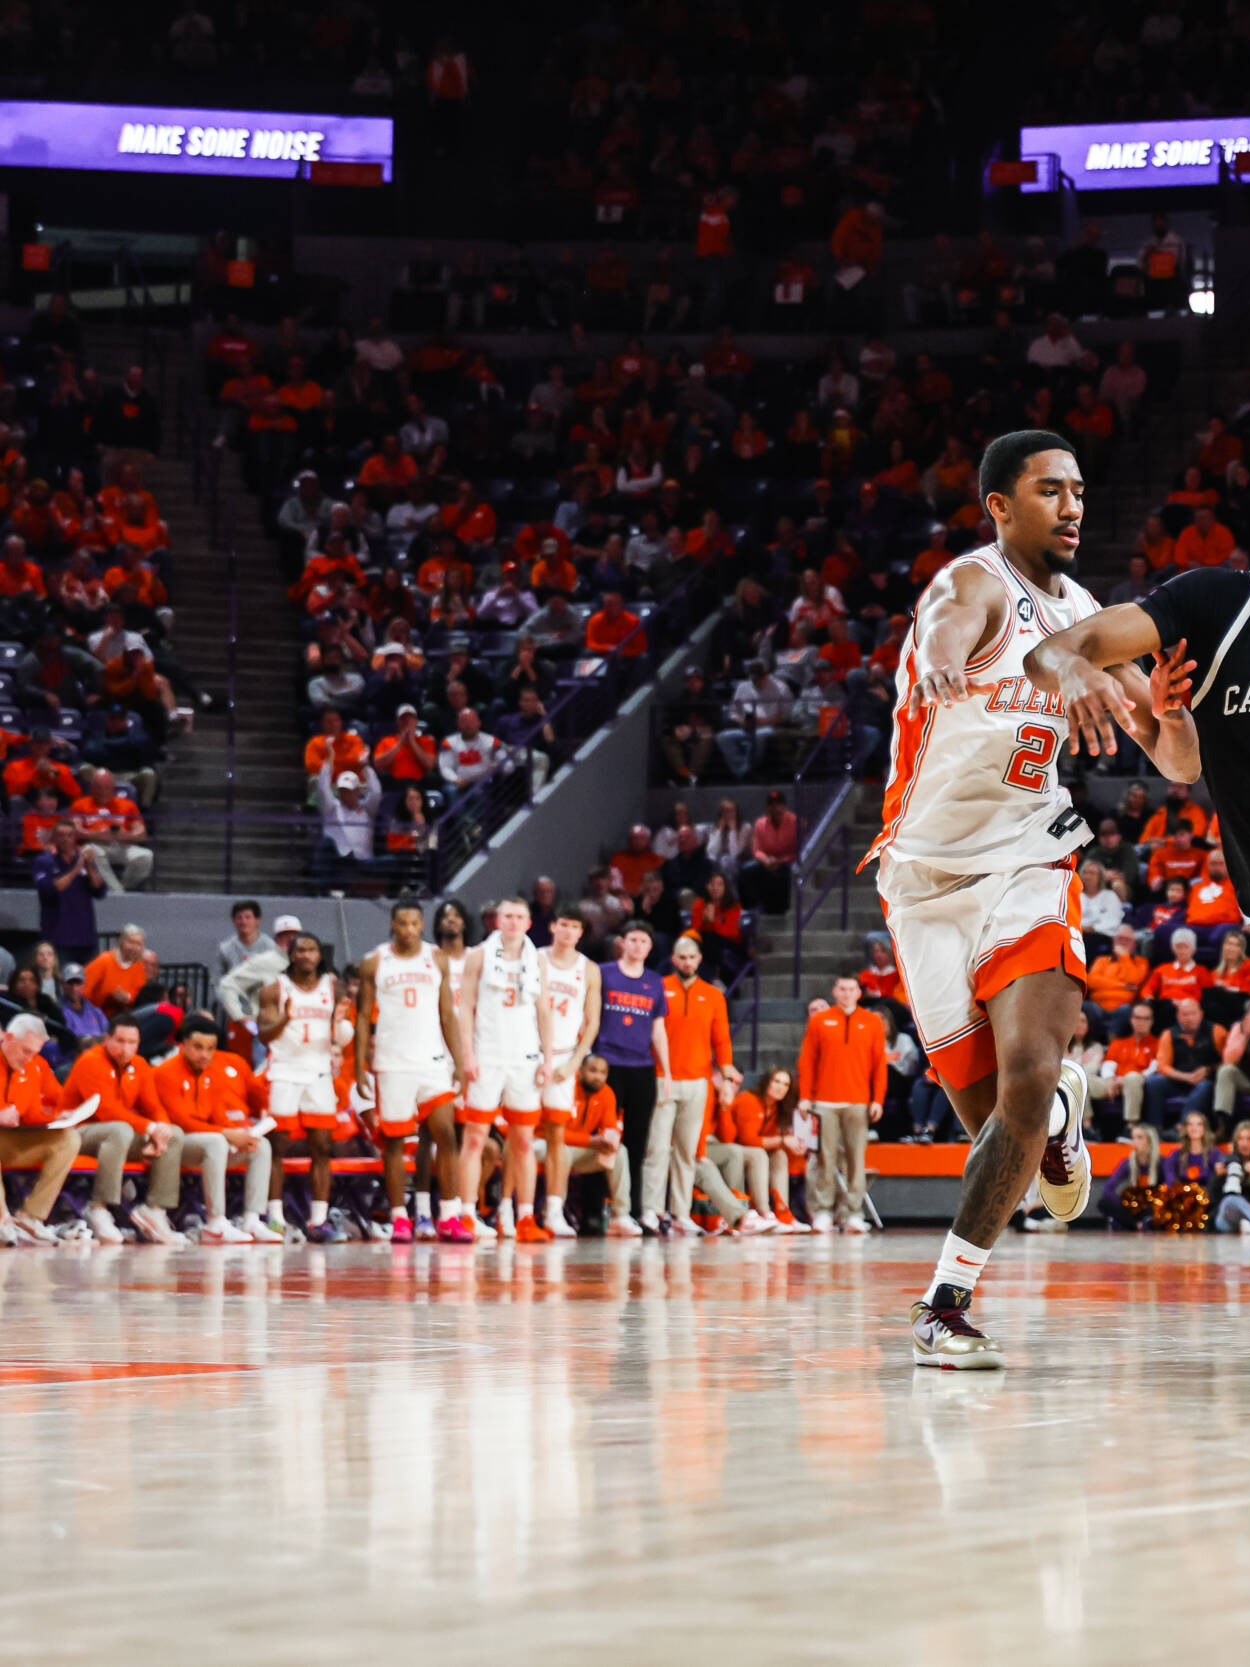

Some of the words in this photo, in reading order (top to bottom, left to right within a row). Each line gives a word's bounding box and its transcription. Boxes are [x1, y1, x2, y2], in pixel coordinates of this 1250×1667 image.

[118, 123, 186, 155] MAKE
[186, 126, 250, 158] SOME
[250, 129, 324, 161] NOISE
[1085, 142, 1150, 170] MAKE
[1151, 139, 1214, 167] SOME
[1019, 601, 1031, 619] 41
[985, 675, 1066, 718] CLEM
[1002, 722, 1059, 794] 2
[404, 988, 417, 1007] 0
[303, 1023, 309, 1043] 1
